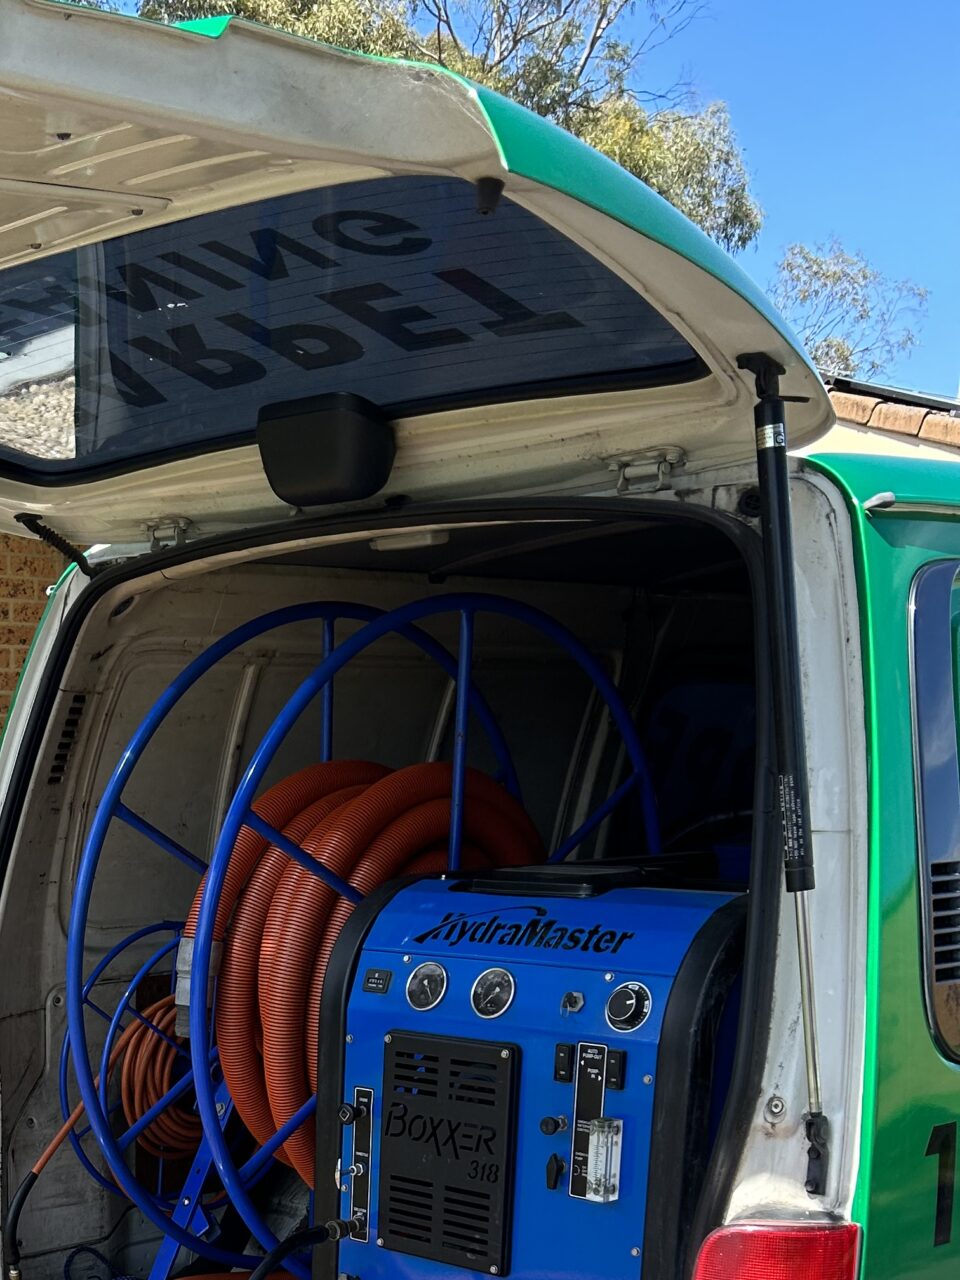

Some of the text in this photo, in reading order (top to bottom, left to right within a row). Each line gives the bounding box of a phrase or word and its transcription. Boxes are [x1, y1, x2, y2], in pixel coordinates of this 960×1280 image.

[413, 906, 635, 954] HydraMaster
[385, 1102, 496, 1160] BOXXER
[467, 1160, 499, 1184] 318
[925, 1121, 957, 1247] 1
